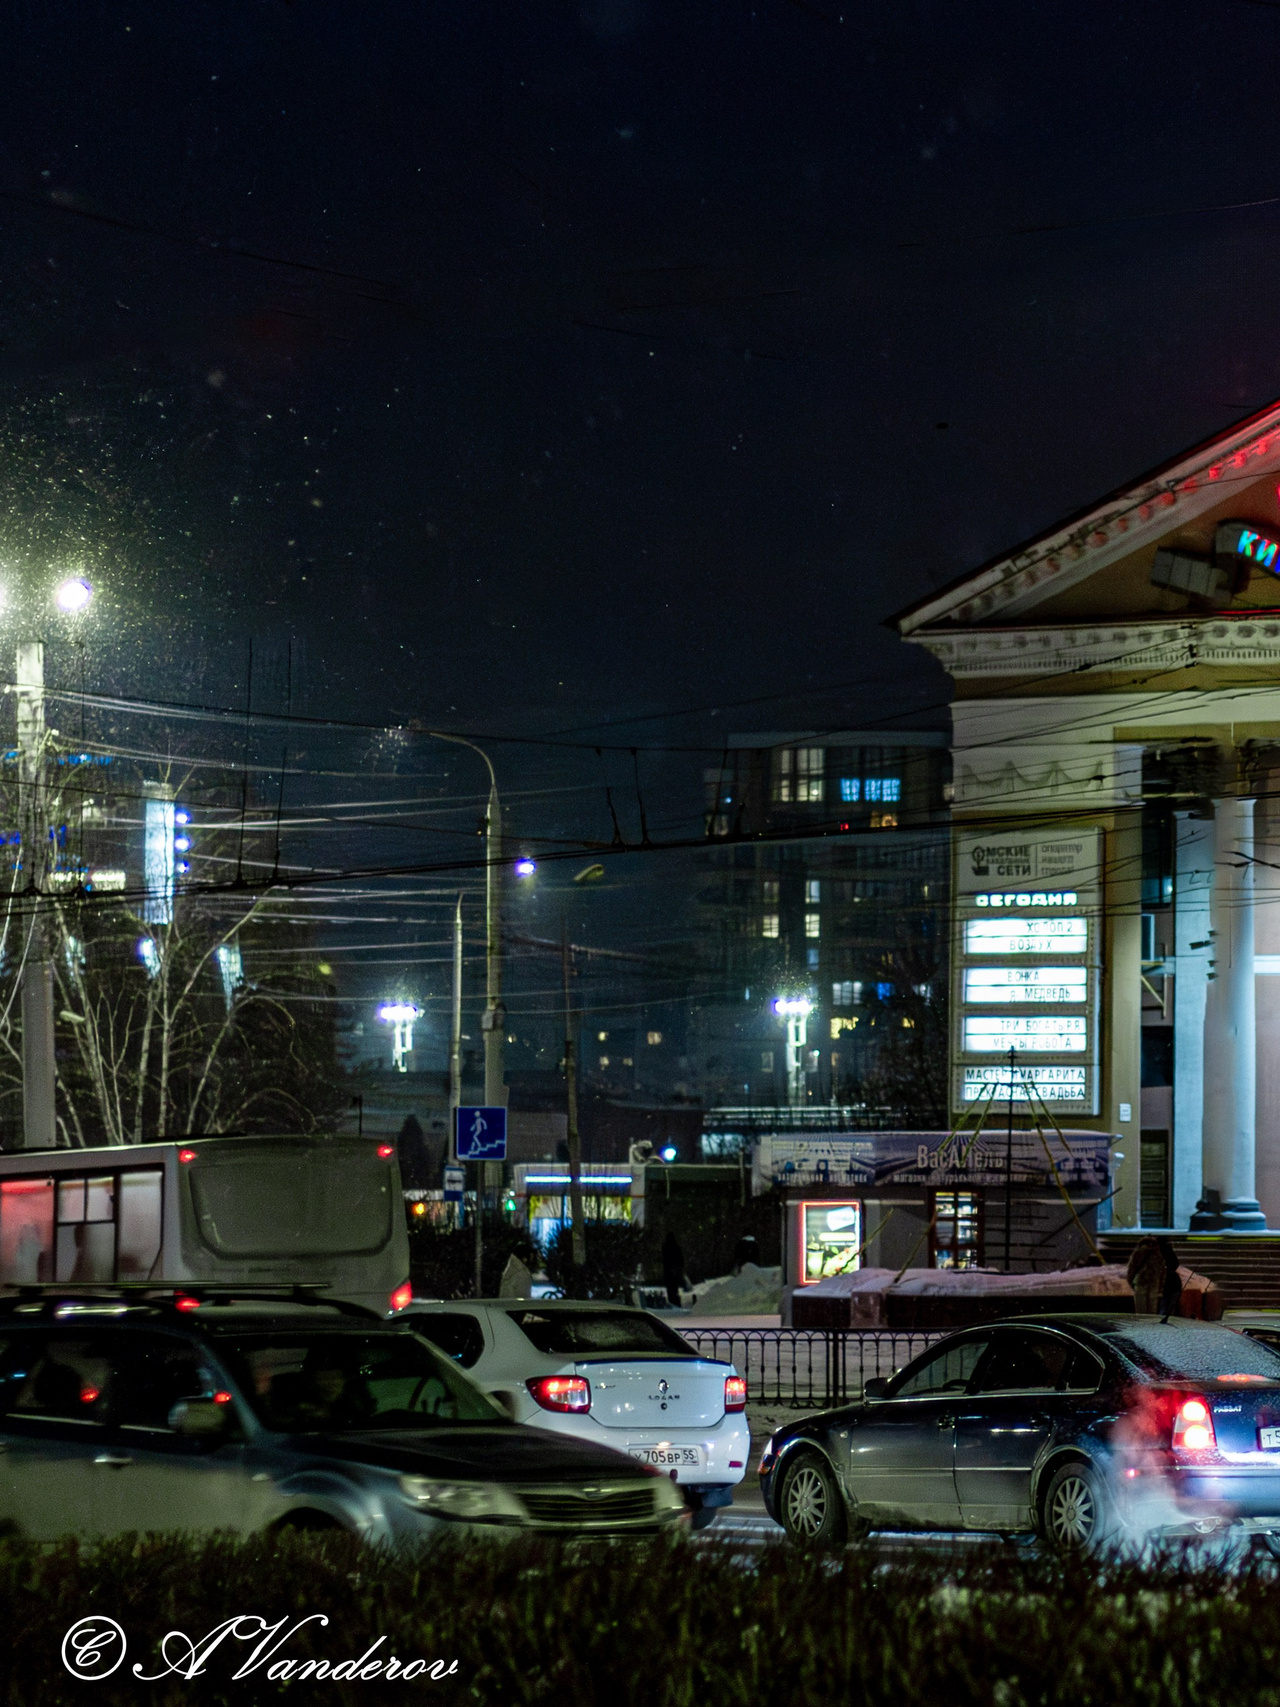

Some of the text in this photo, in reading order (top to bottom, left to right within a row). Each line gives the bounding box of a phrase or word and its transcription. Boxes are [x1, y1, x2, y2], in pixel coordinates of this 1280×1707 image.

[996, 864, 1032, 877] СЕТИ
[1066, 921, 1074, 933] 2
[1006, 970, 1040, 983] ВОНКА
[1024, 987, 1071, 1002] МЕДВЕДЬ
[1000, 1019, 1019, 1032] ТРИ
